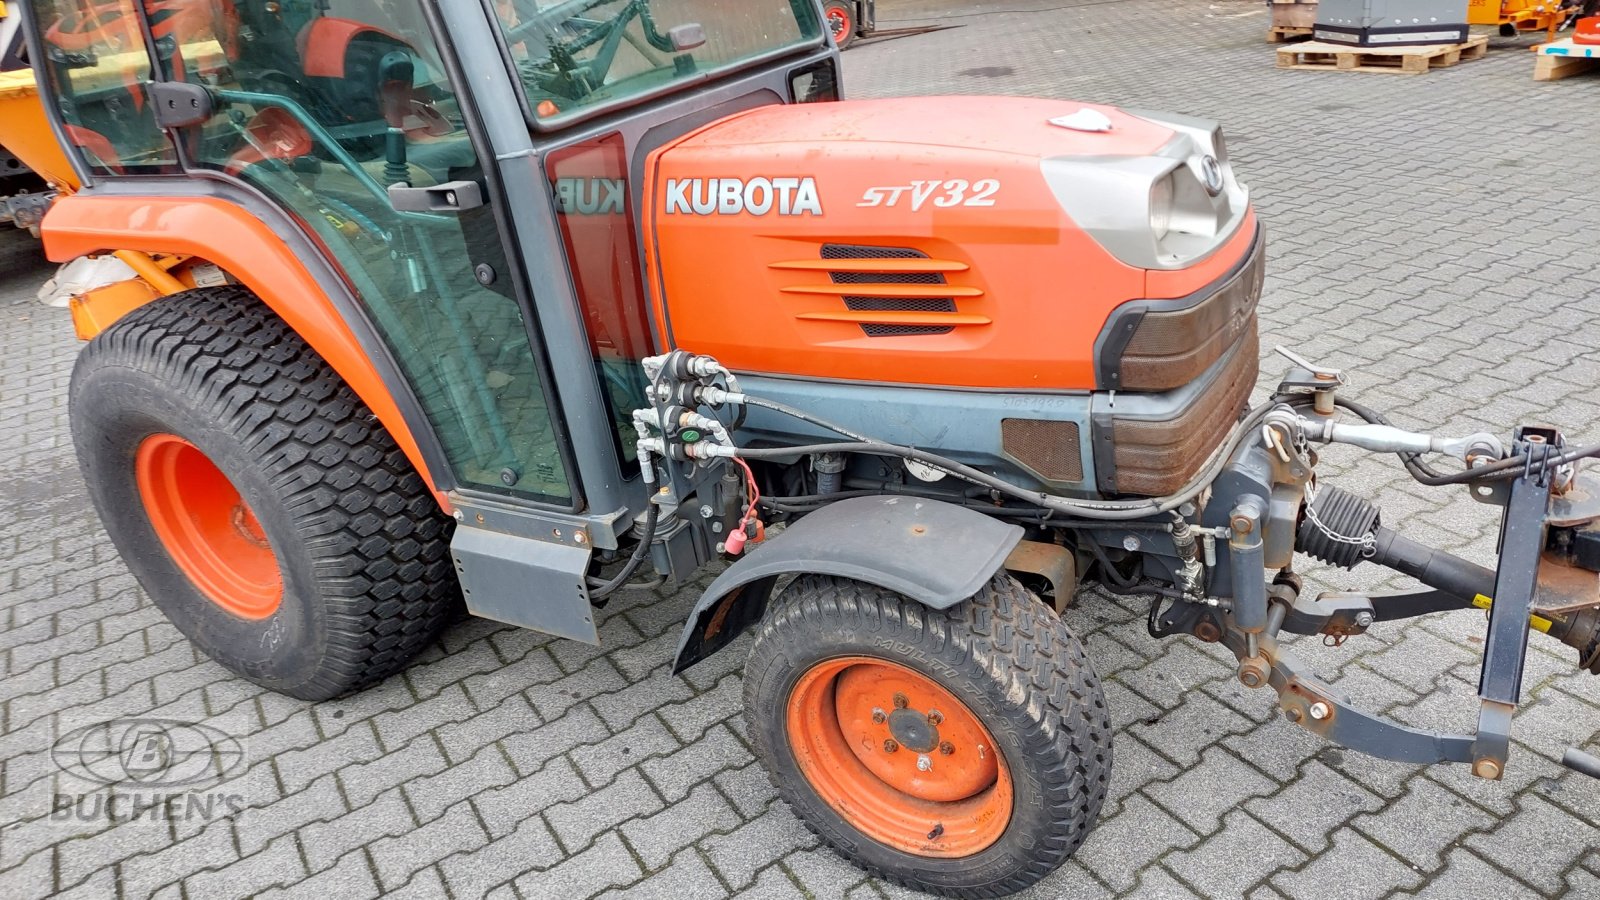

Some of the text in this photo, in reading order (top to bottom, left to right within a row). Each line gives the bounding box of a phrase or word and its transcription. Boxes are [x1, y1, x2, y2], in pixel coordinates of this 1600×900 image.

[665, 177, 1000, 216] KUBOTA STV32
[873, 635, 960, 678] MULTI
